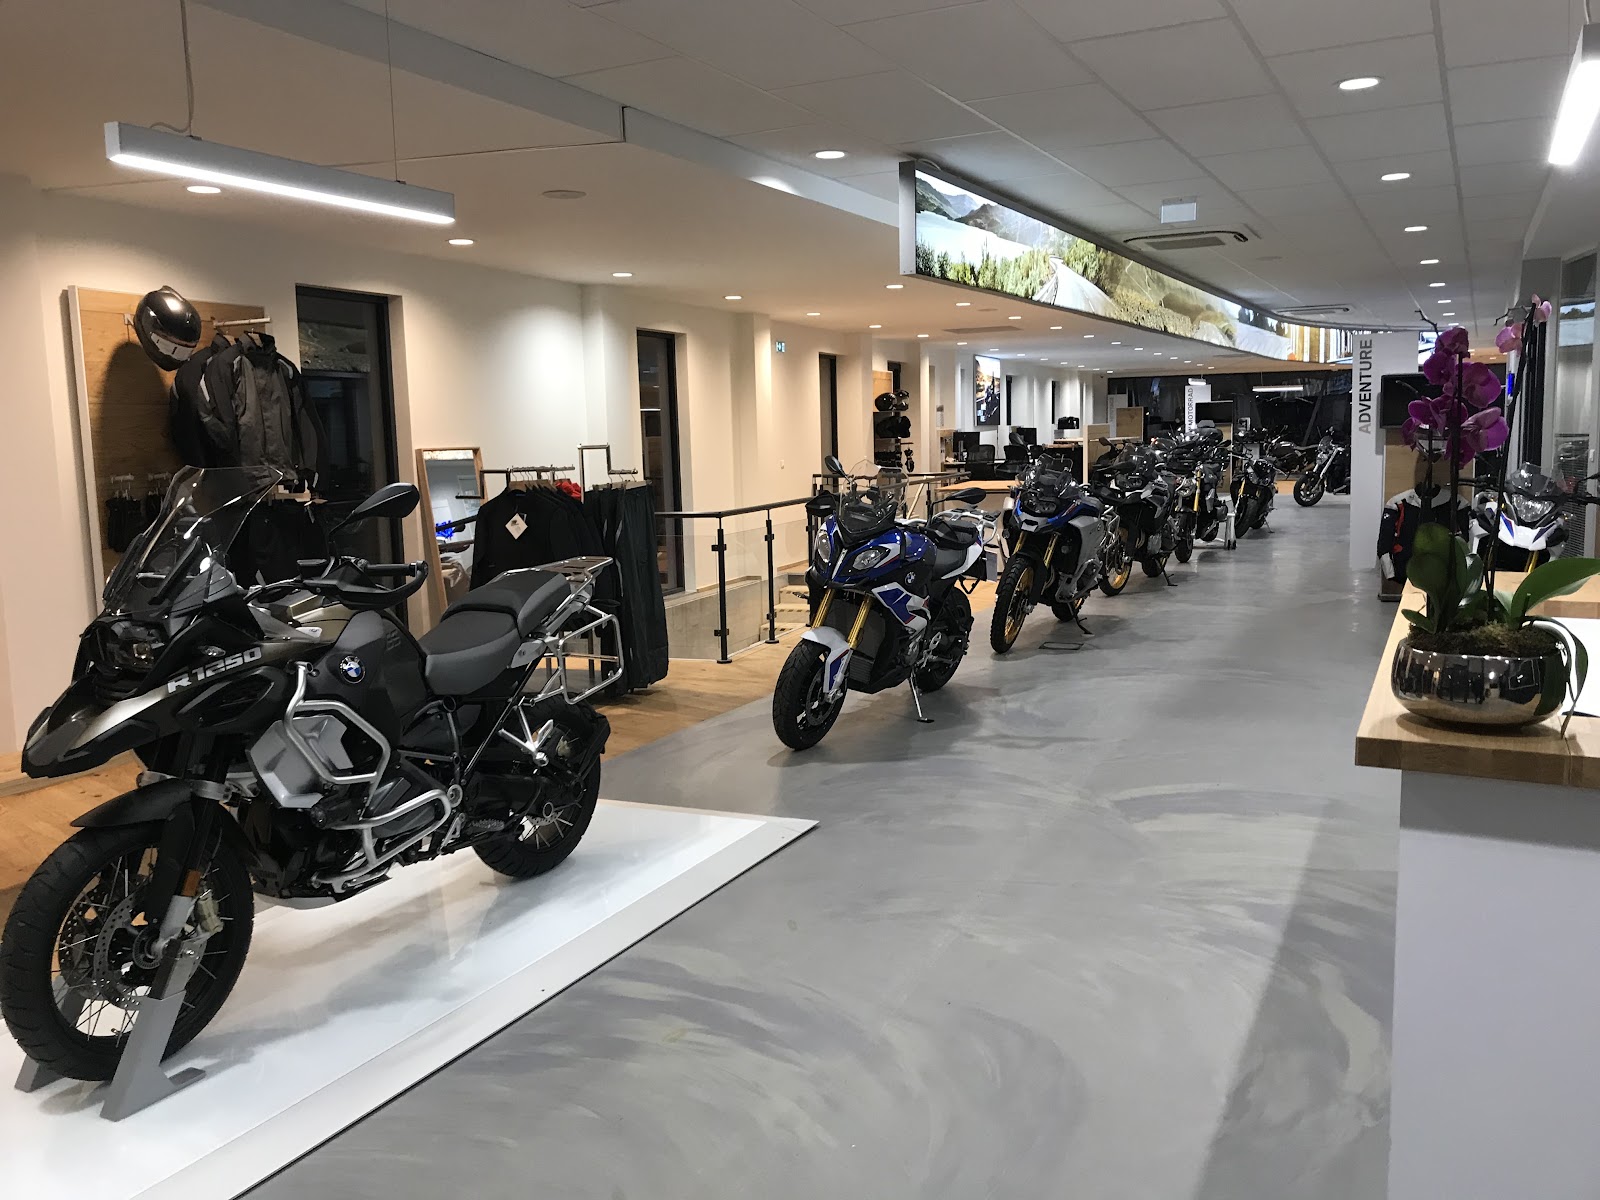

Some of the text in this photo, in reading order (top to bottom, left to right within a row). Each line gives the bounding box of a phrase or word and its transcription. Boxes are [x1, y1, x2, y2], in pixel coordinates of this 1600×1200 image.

[1359, 339, 1372, 434] ADVENTURE
[167, 647, 262, 693] R 1250
